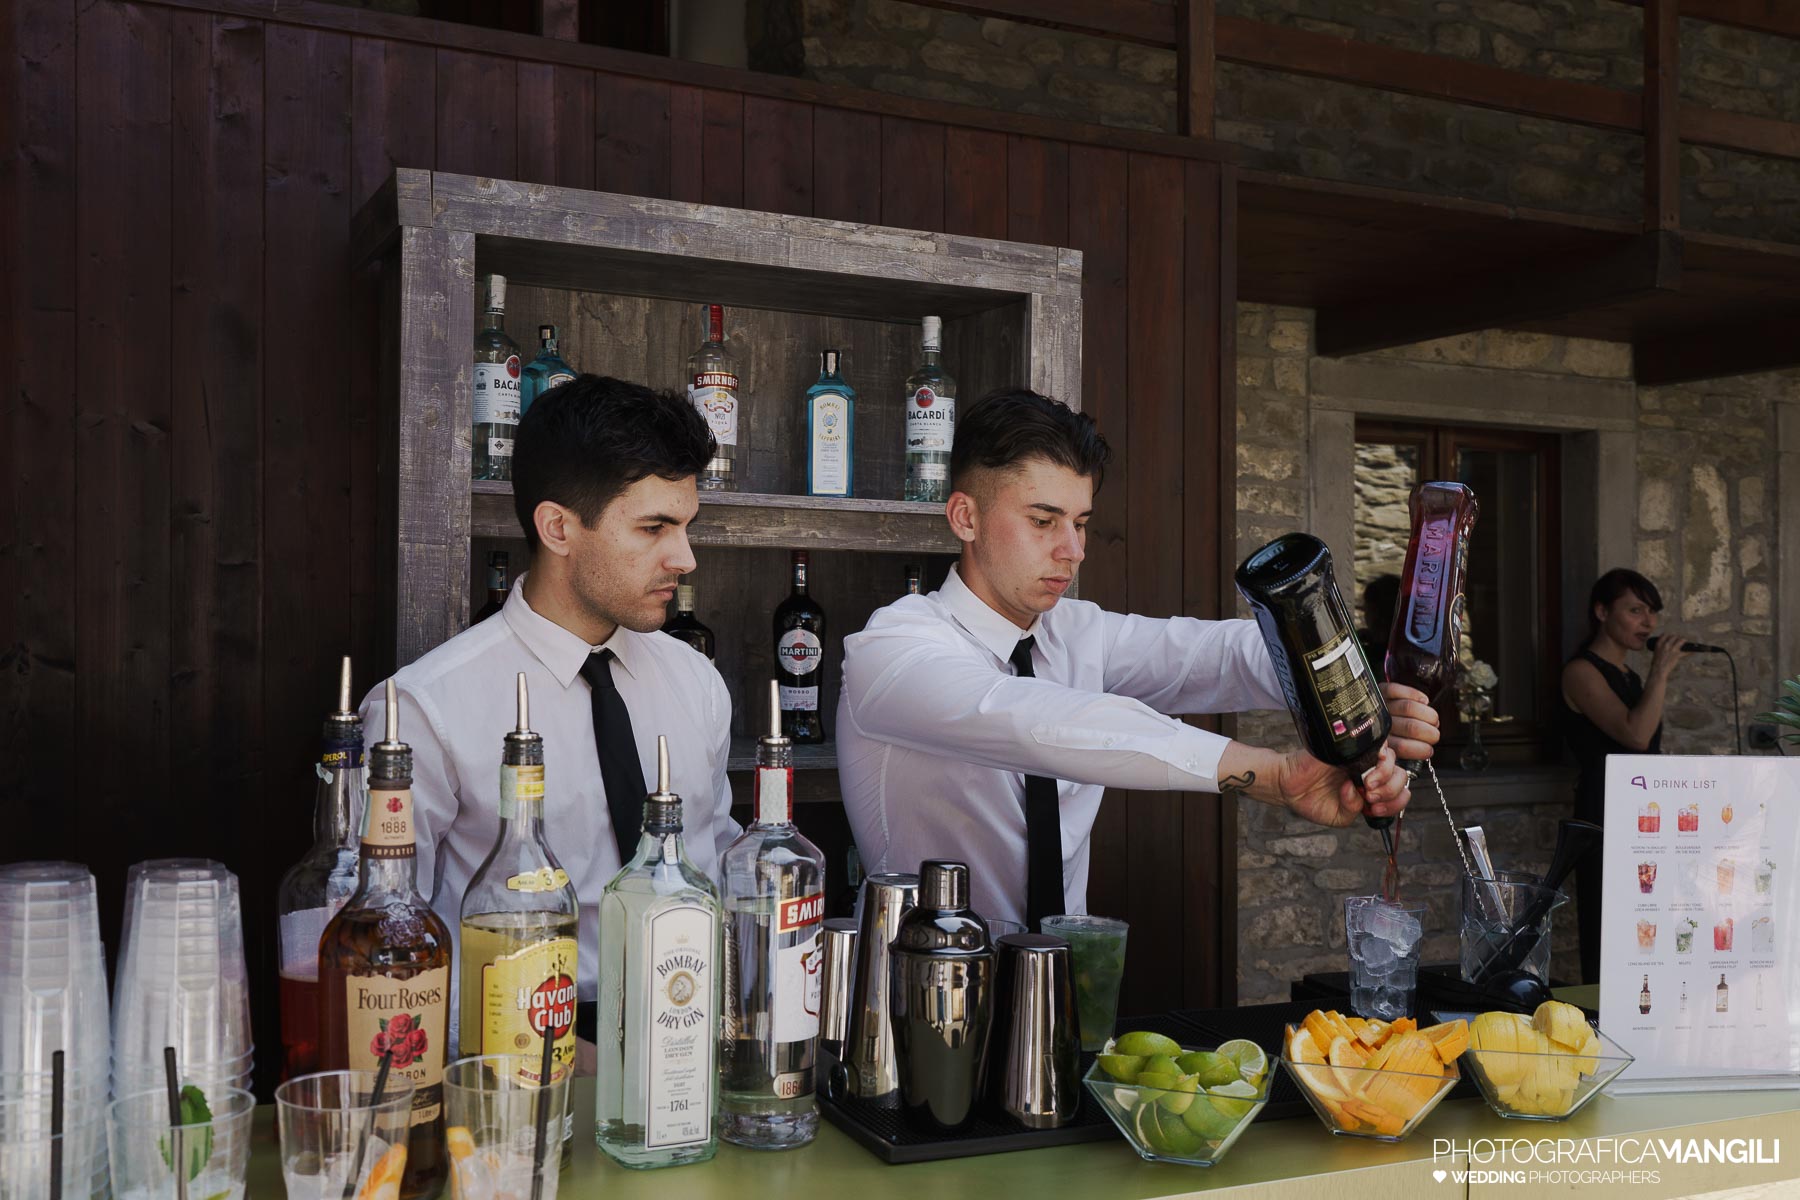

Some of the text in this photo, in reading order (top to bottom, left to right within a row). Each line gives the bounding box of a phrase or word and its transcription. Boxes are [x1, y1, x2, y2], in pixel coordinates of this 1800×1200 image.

[697, 374, 738, 388] SMIRNOFF
[908, 409, 945, 420] BACARDÍ
[1416, 526, 1443, 626] MARTINI
[781, 647, 817, 656] MARTINI
[322, 751, 348, 762] APEROL
[1653, 780, 1718, 789] DRINK LIST
[381, 820, 406, 833] 1888
[371, 847, 414, 855] IMPORTED
[656, 955, 707, 979] BOMBAY
[358, 987, 442, 1010] Four Roses
[534, 1006, 571, 1032] Club
[656, 1008, 705, 1030] DRY GIN
[552, 1047, 563, 1061] 3
[670, 1099, 688, 1112] 1761
